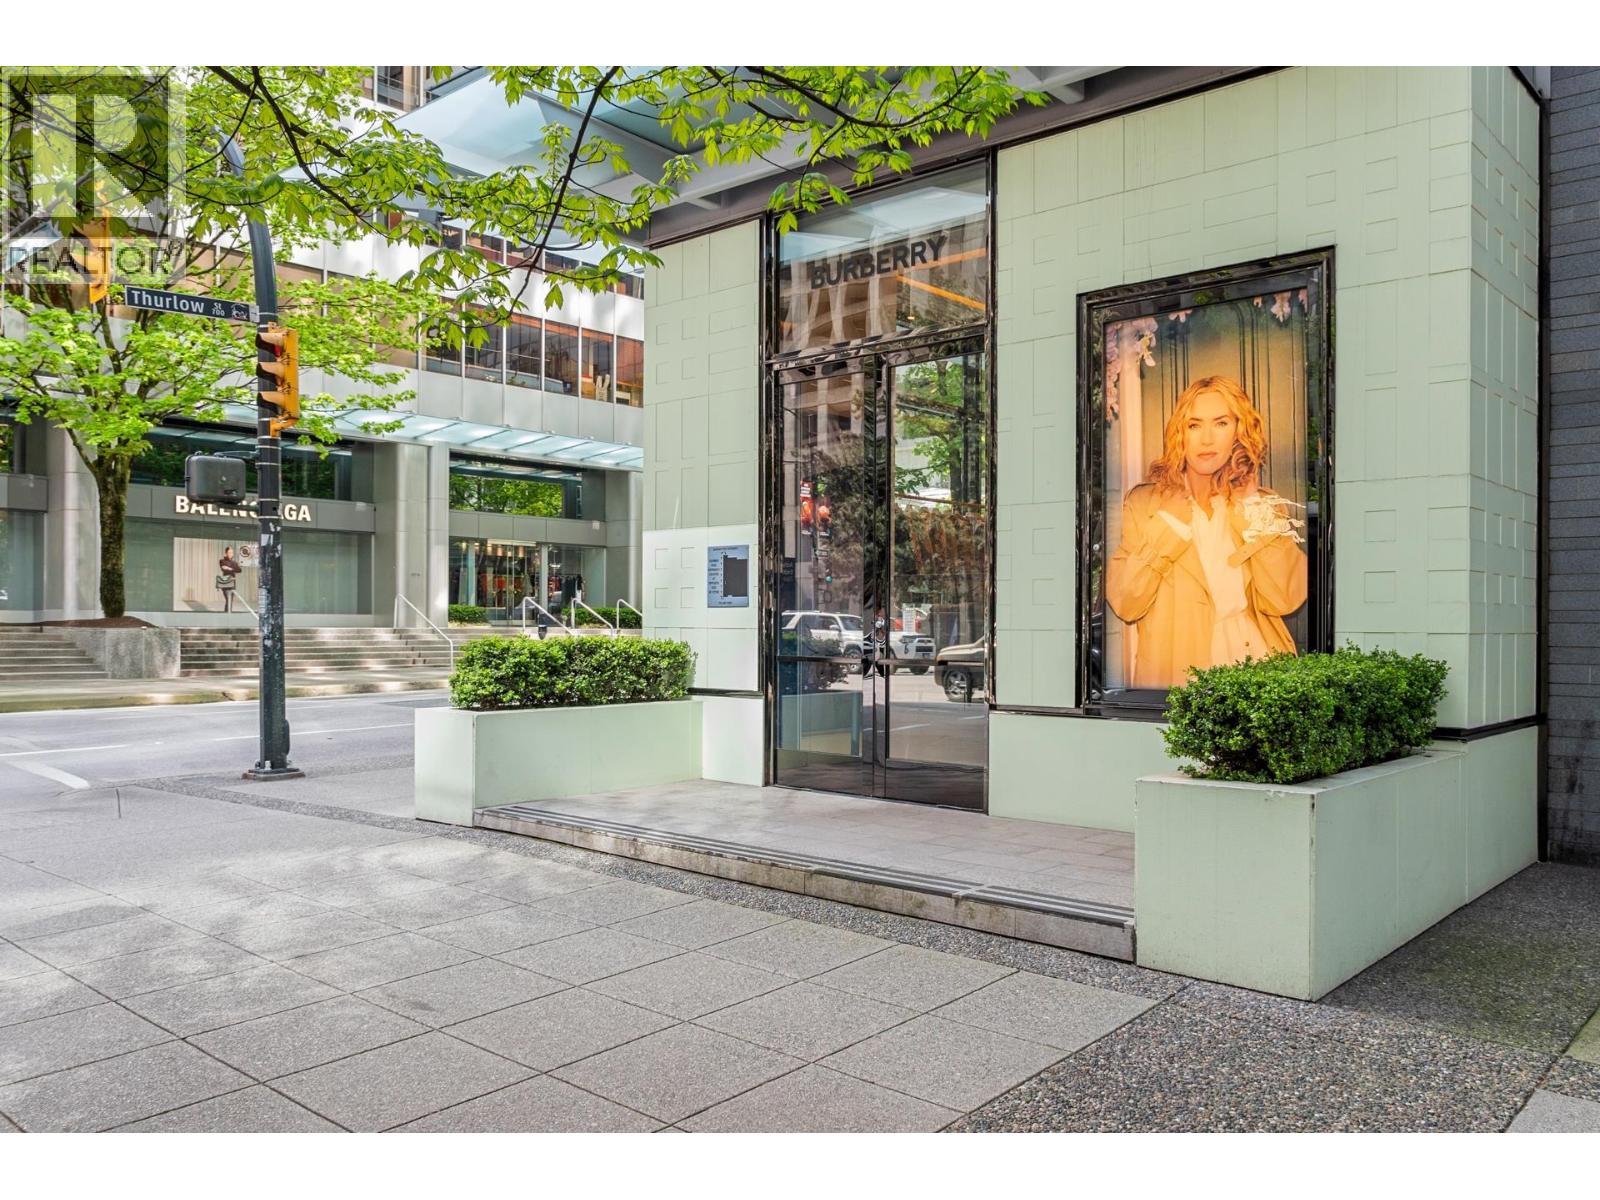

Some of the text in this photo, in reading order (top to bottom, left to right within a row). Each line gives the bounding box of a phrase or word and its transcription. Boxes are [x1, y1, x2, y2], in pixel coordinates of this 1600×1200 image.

[810, 234, 949, 290] BURBERRY
[131, 289, 223, 314] Thurlow St
